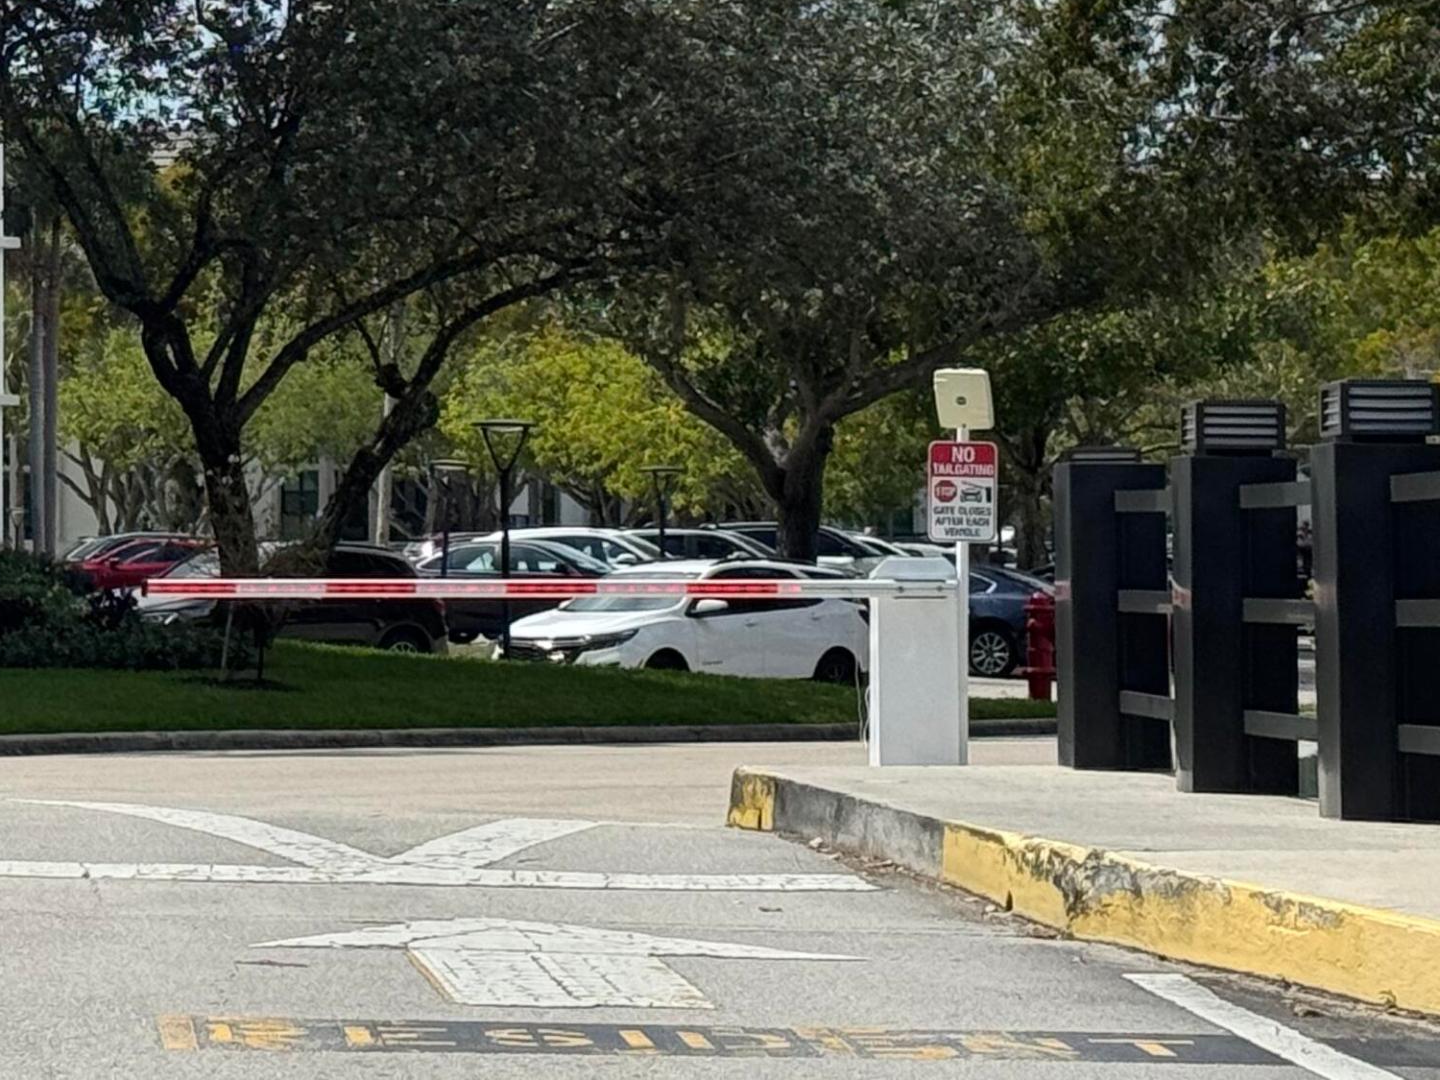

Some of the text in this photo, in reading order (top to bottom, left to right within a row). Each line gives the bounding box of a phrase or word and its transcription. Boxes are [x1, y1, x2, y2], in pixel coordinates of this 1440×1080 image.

[951, 446, 976, 463] NO
[933, 462, 994, 475] TAILGATING
[208, 1018, 1195, 1058] RESIDENT
